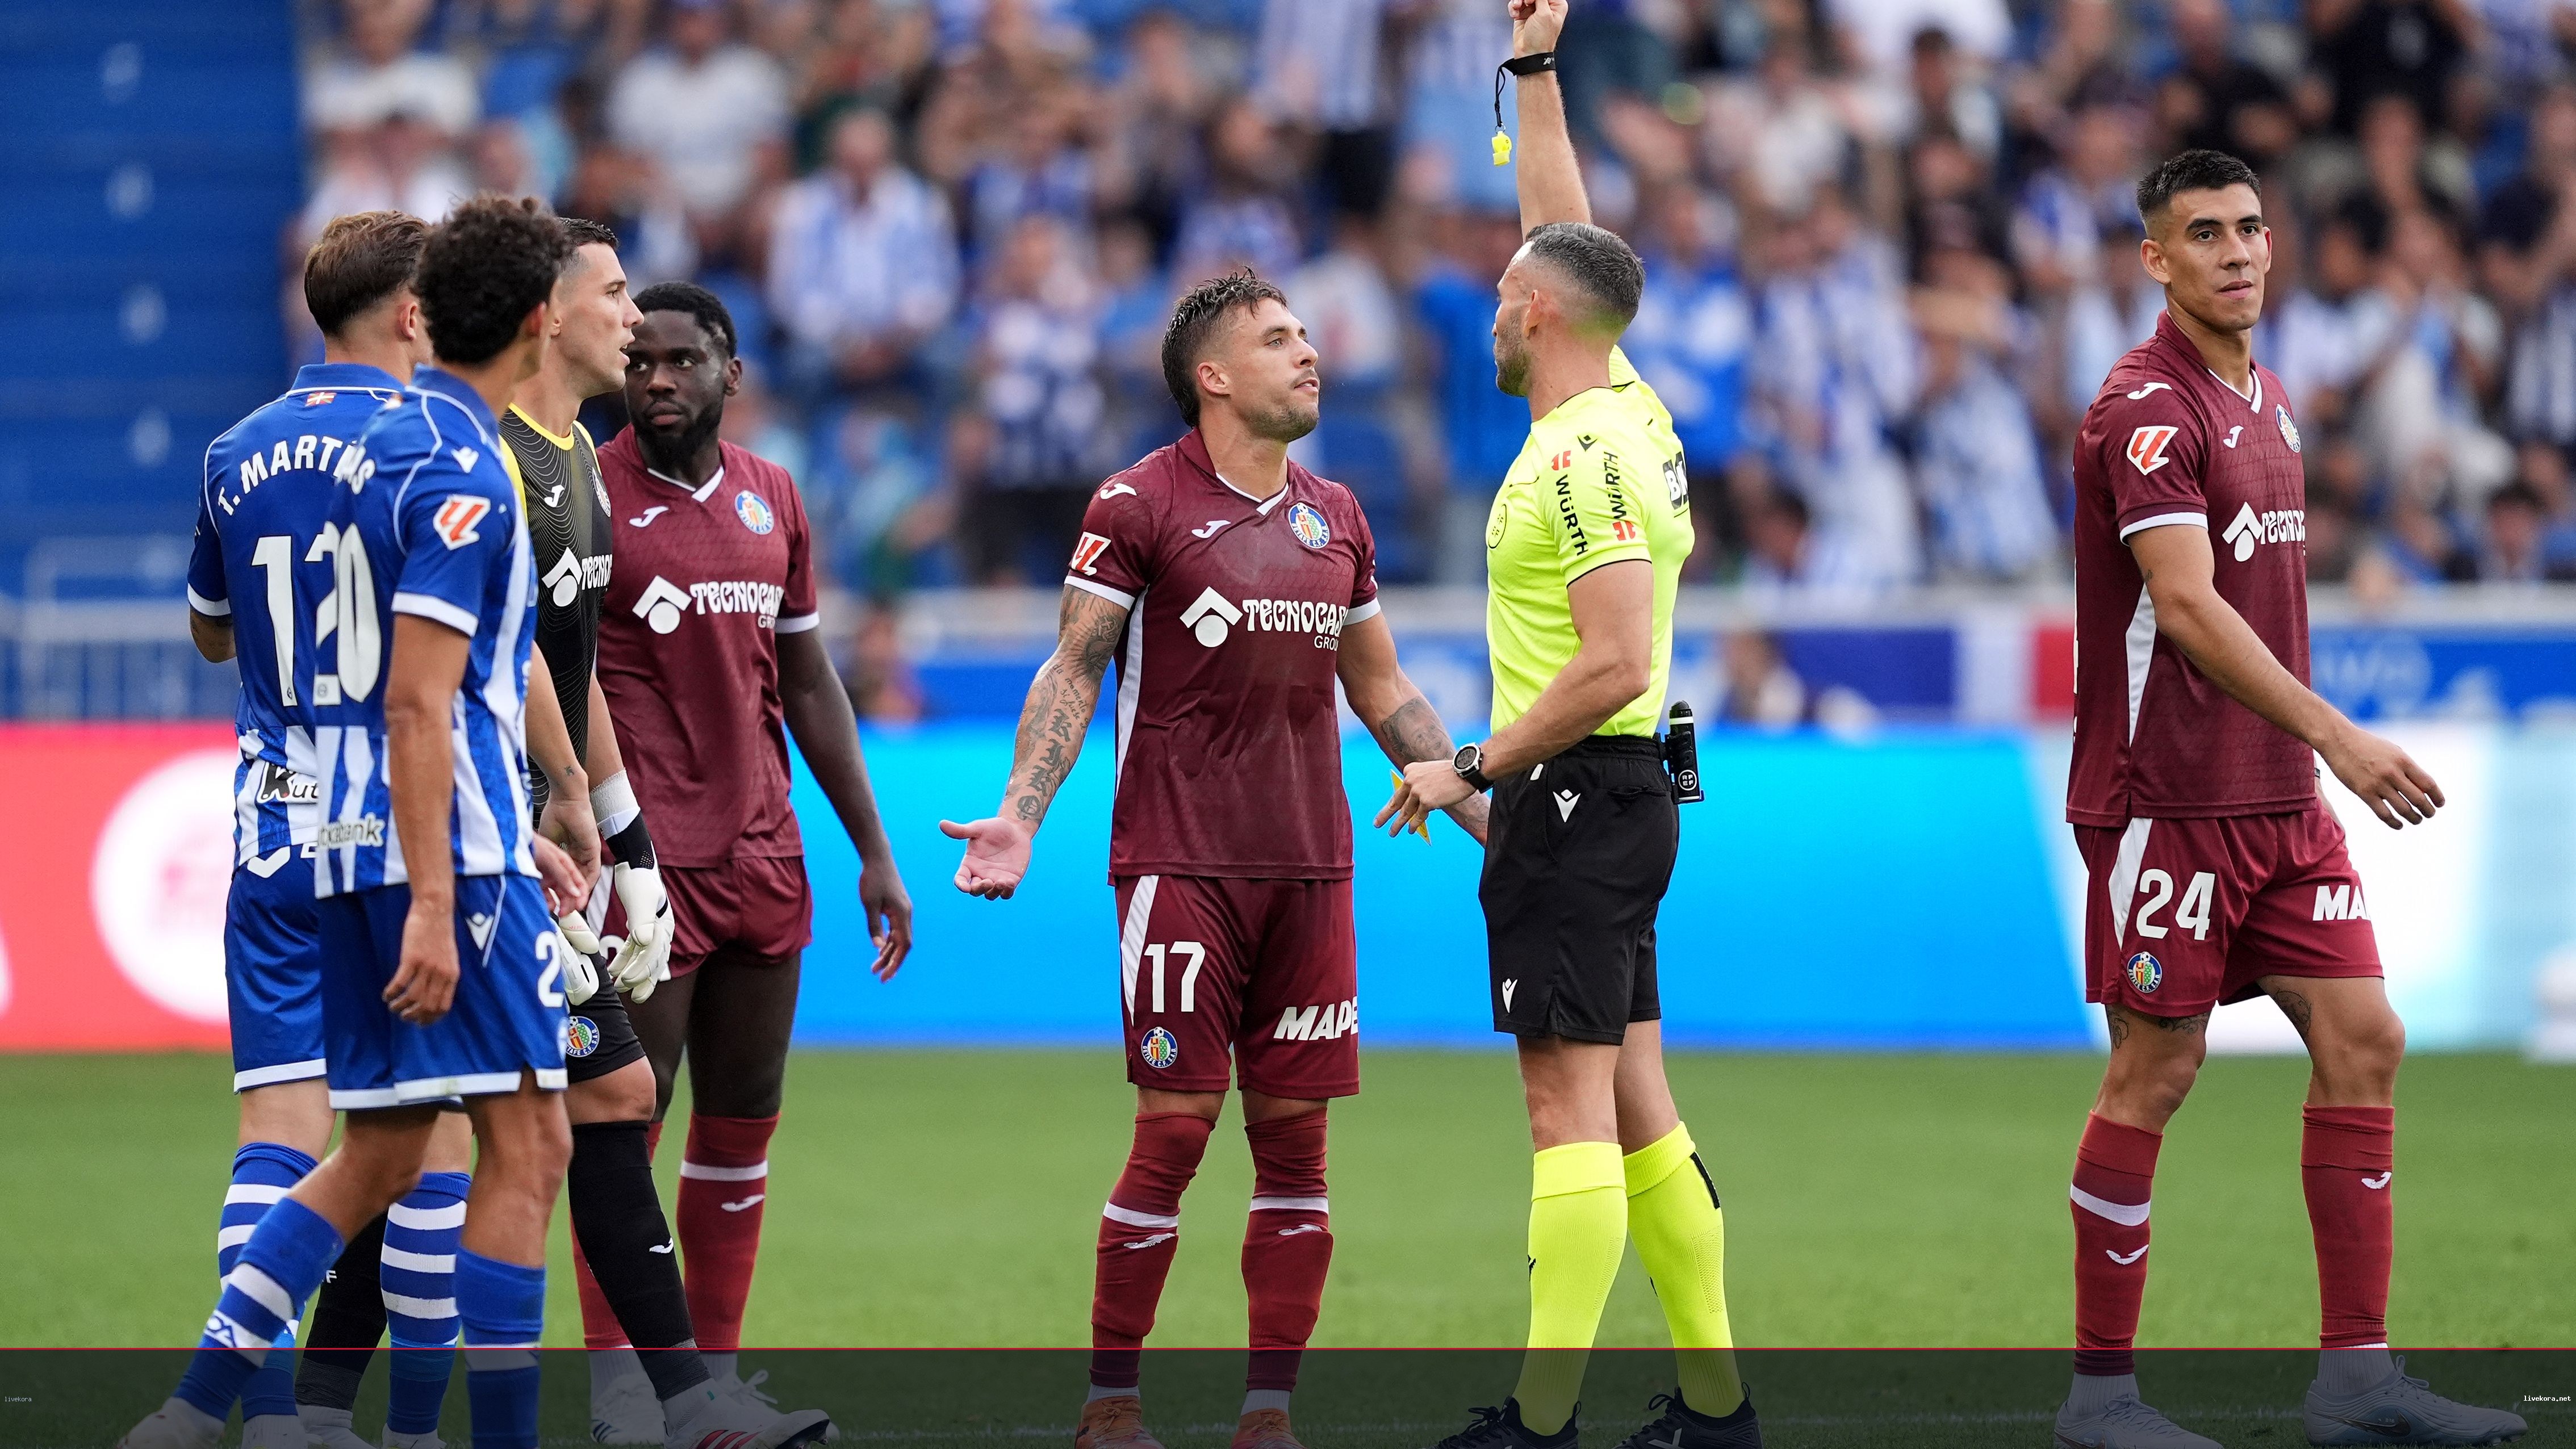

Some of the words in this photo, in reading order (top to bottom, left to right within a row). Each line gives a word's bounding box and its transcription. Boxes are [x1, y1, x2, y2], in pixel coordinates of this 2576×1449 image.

[218, 486, 241, 516] T.
[1604, 451, 1627, 519] WÜRTH
[1556, 474, 1588, 556] WÜRTH
[1242, 598, 1349, 637] TECNOCAS
[1314, 635, 1339, 652] GROU
[2136, 869, 2215, 940] 24
[2312, 885, 2372, 921] MA
[1144, 941, 1206, 1013] 17
[1273, 995, 1358, 1041] MAPE
[566, 1045, 581, 1056] TAFE
